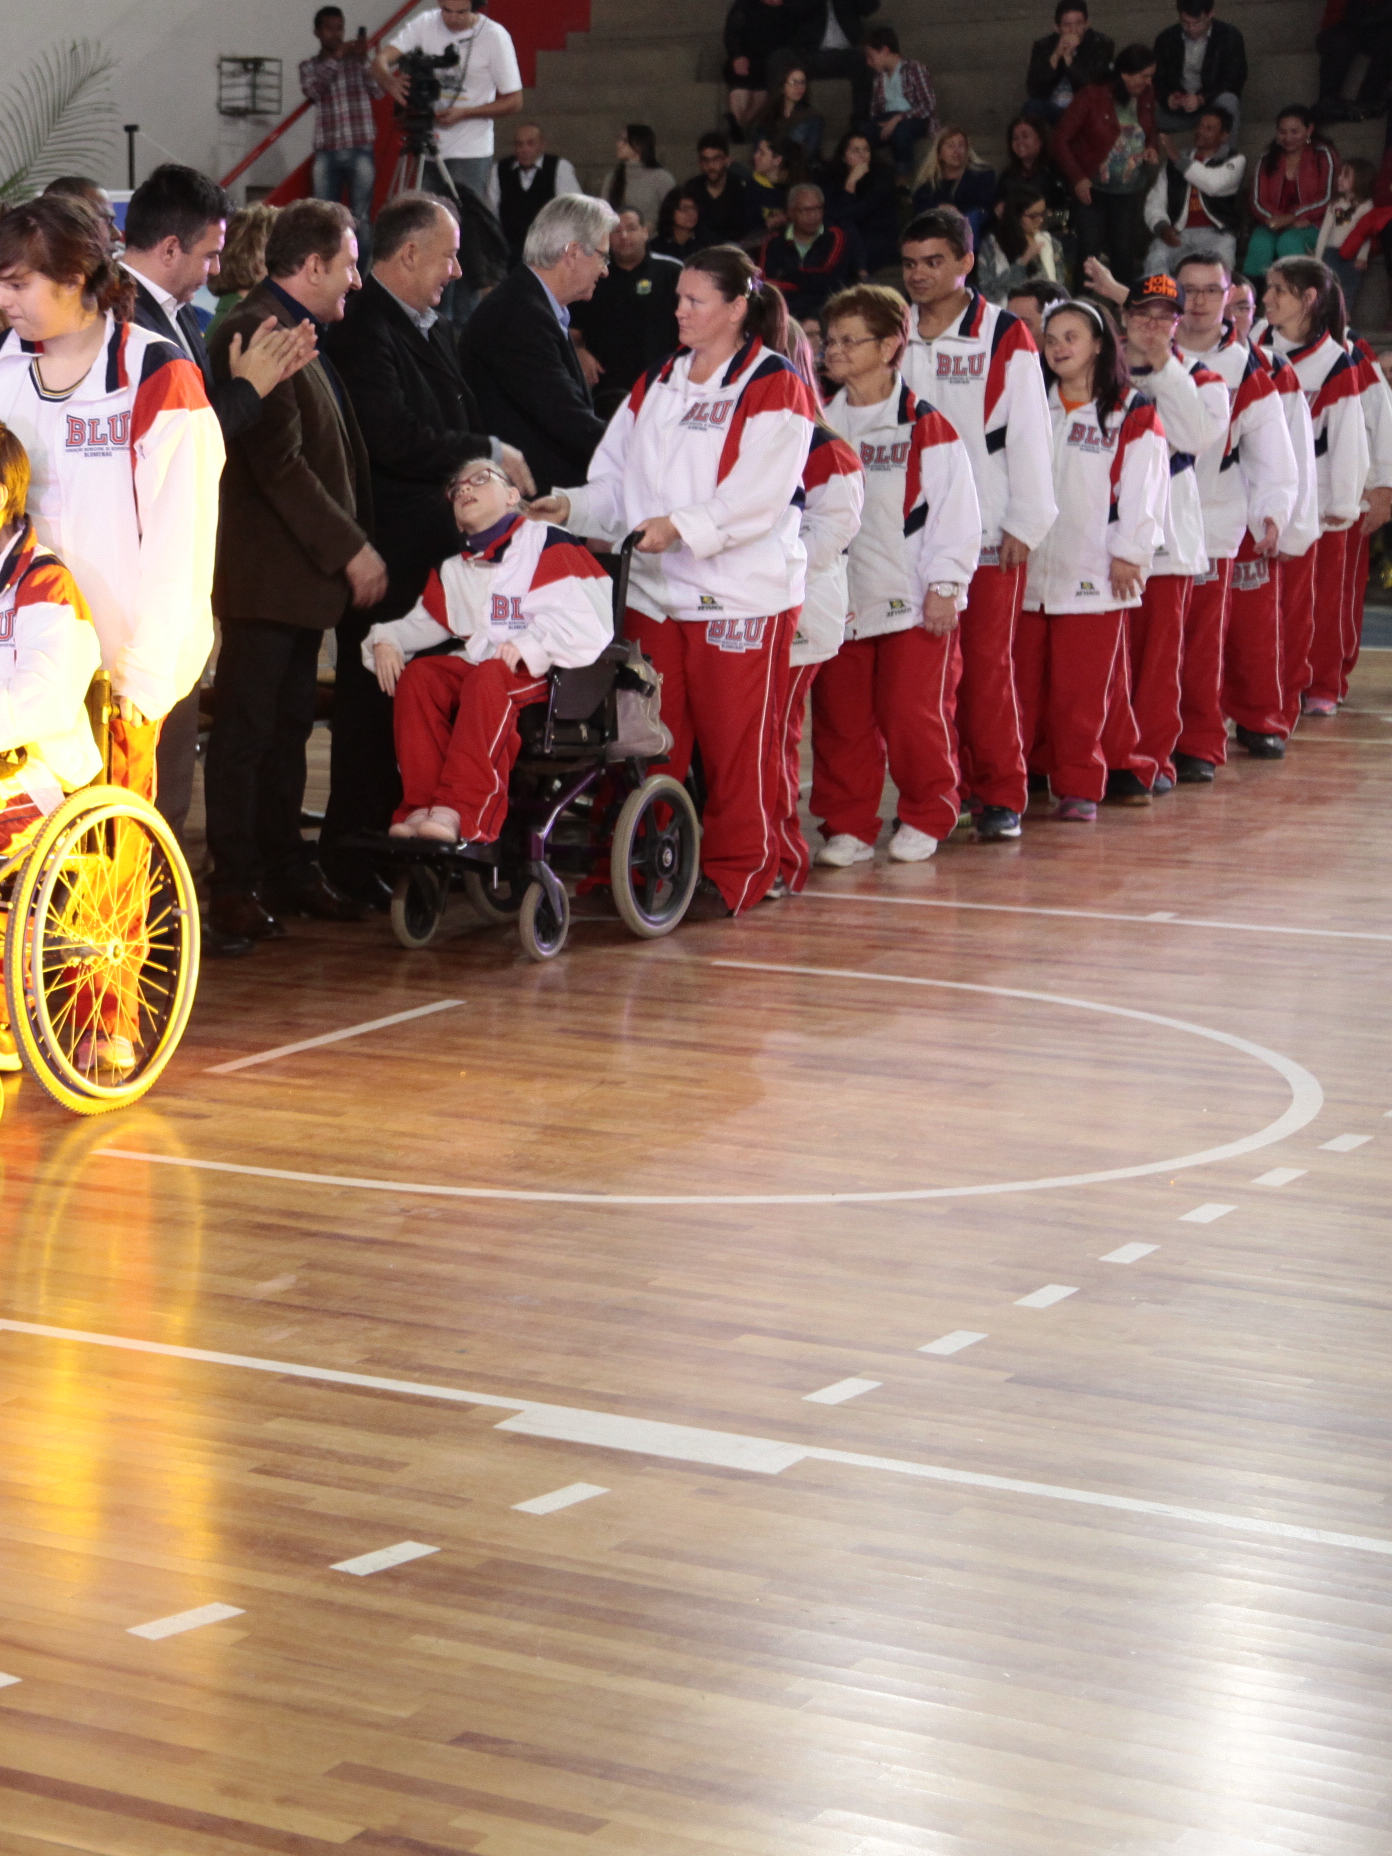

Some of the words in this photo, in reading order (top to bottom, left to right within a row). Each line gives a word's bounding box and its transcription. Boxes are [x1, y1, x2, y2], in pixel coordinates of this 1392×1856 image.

[936, 352, 986, 376] BLU
[65, 410, 131, 447] BLU
[860, 441, 910, 465] BLU
[491, 594, 526, 621] BL
[709, 616, 767, 642] BLU
